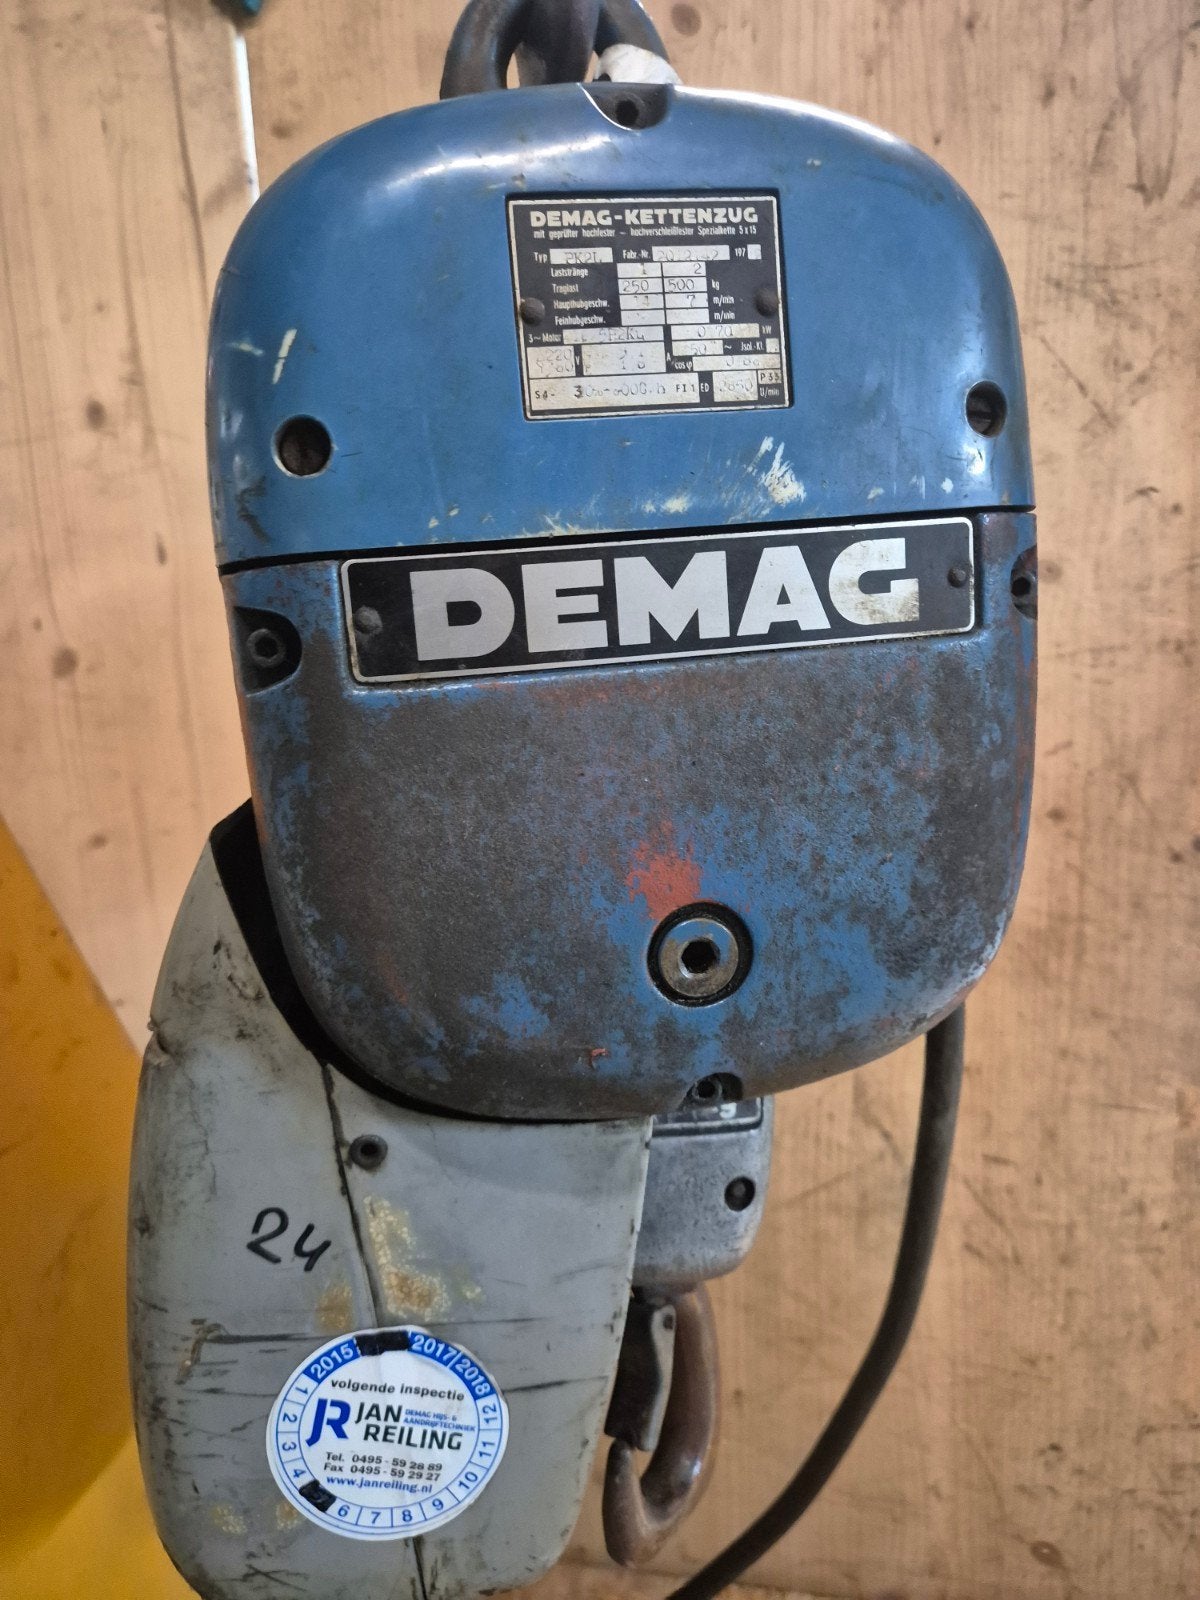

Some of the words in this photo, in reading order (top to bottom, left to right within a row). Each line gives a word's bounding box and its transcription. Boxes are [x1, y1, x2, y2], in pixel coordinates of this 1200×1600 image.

[530, 207, 758, 227] DEMAG-KETTENZUG
[534, 230, 545, 239] mit
[549, 228, 578, 240] geprüfter
[582, 228, 615, 238] hochfester
[698, 225, 736, 237] Spezialkette
[534, 252, 547, 263] Typ
[551, 268, 589, 278] Laststränge
[693, 263, 702, 275] 2
[552, 283, 579, 295] Traglast
[622, 280, 649, 294] 250
[668, 279, 695, 292] 500
[711, 280, 720, 291] kg
[553, 298, 610, 311] Haupthubgeschw.
[713, 295, 735, 307] m/min
[555, 314, 606, 327] Feinhubgeschw.
[714, 311, 736, 323] m/min
[701, 385, 710, 393] ED
[760, 387, 780, 398] U/min
[409, 537, 920, 661] DEMAG
[246, 1206, 332, 1272] 24
[311, 1343, 354, 1379] 2015
[411, 1334, 458, 1362] 2017
[455, 1358, 491, 1396] 2018
[295, 1386, 309, 1396] 1
[331, 1379, 395, 1394] volgende
[400, 1383, 465, 1401] inspectie
[282, 1412, 298, 1423] 2
[355, 1402, 403, 1424] JAN
[482, 1403, 498, 1424] 12
[363, 1423, 463, 1450] REILING
[281, 1441, 297, 1452] 3
[478, 1440, 495, 1458] 11
[326, 1451, 345, 1462] Tel.
[352, 1454, 382, 1465] 0495
[391, 1457, 407, 1468] 59
[409, 1460, 425, 1470] 28
[427, 1462, 443, 1472] 89
[293, 1467, 307, 1478] 4
[324, 1462, 344, 1473] Fax
[350, 1464, 380, 1475] 0495
[390, 1467, 405, 1478] 59
[407, 1470, 423, 1480] 29
[426, 1472, 441, 1482] 27
[326, 1476, 433, 1494] www.janreiling.nl
[458, 1471, 478, 1490] 10
[337, 1504, 350, 1518] 6
[432, 1498, 444, 1511] 9
[371, 1511, 382, 1524] 7
[402, 1509, 413, 1523] 8
